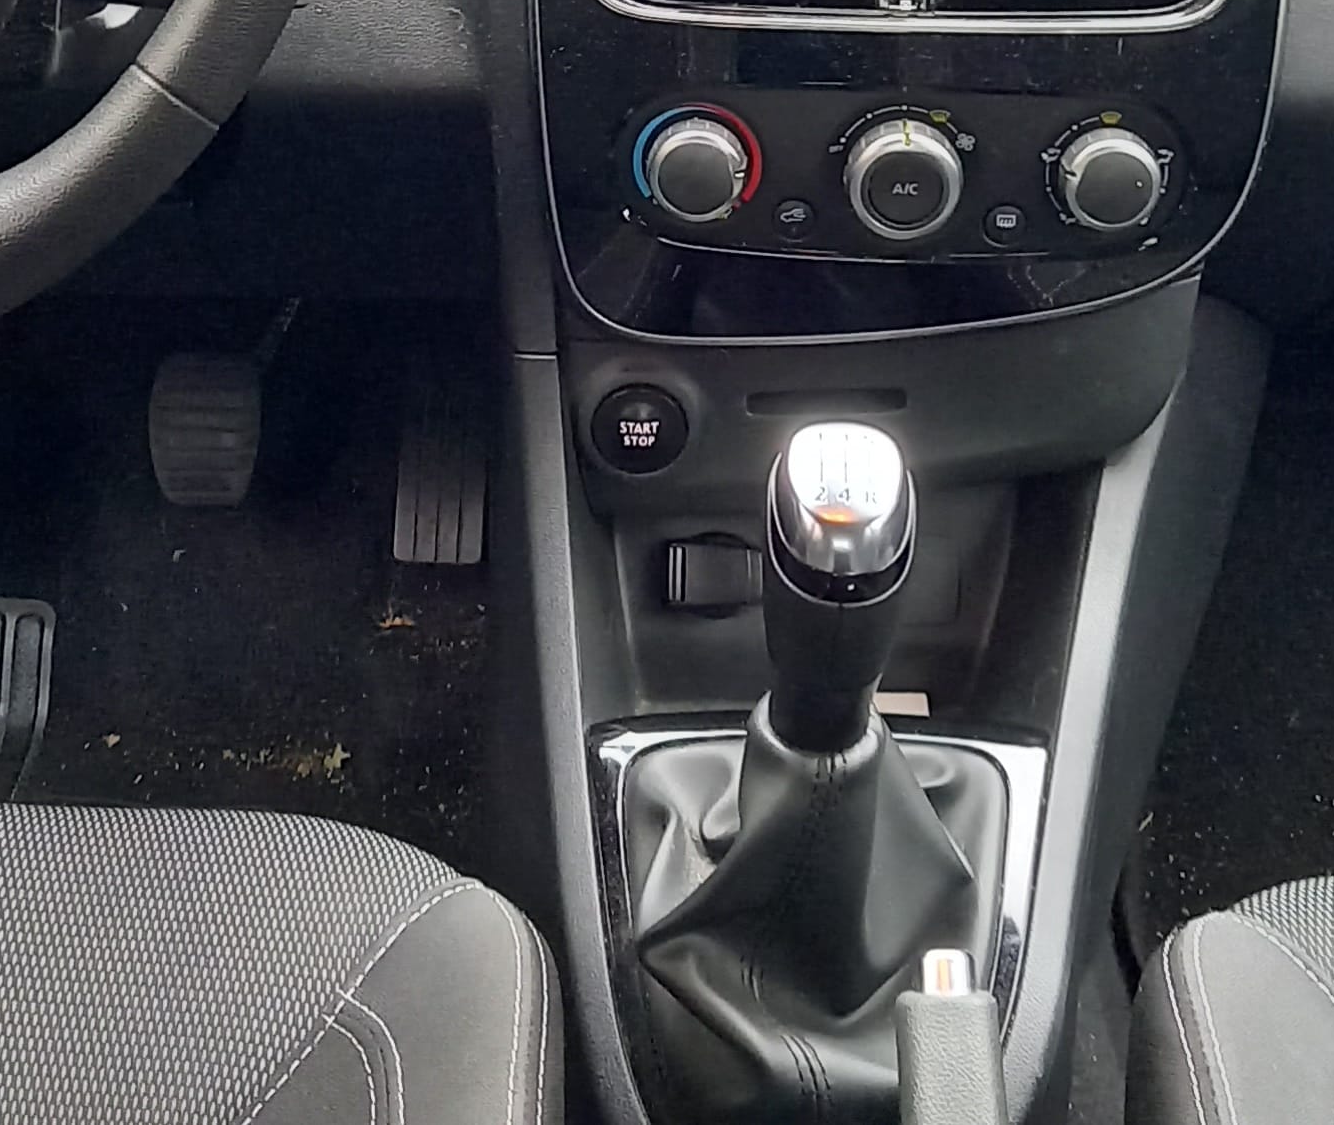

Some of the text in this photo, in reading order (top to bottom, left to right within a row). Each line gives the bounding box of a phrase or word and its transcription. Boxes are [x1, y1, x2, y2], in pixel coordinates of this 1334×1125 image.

[892, 183, 919, 195] A/C
[619, 421, 659, 434] START
[623, 435, 655, 447] STOP
